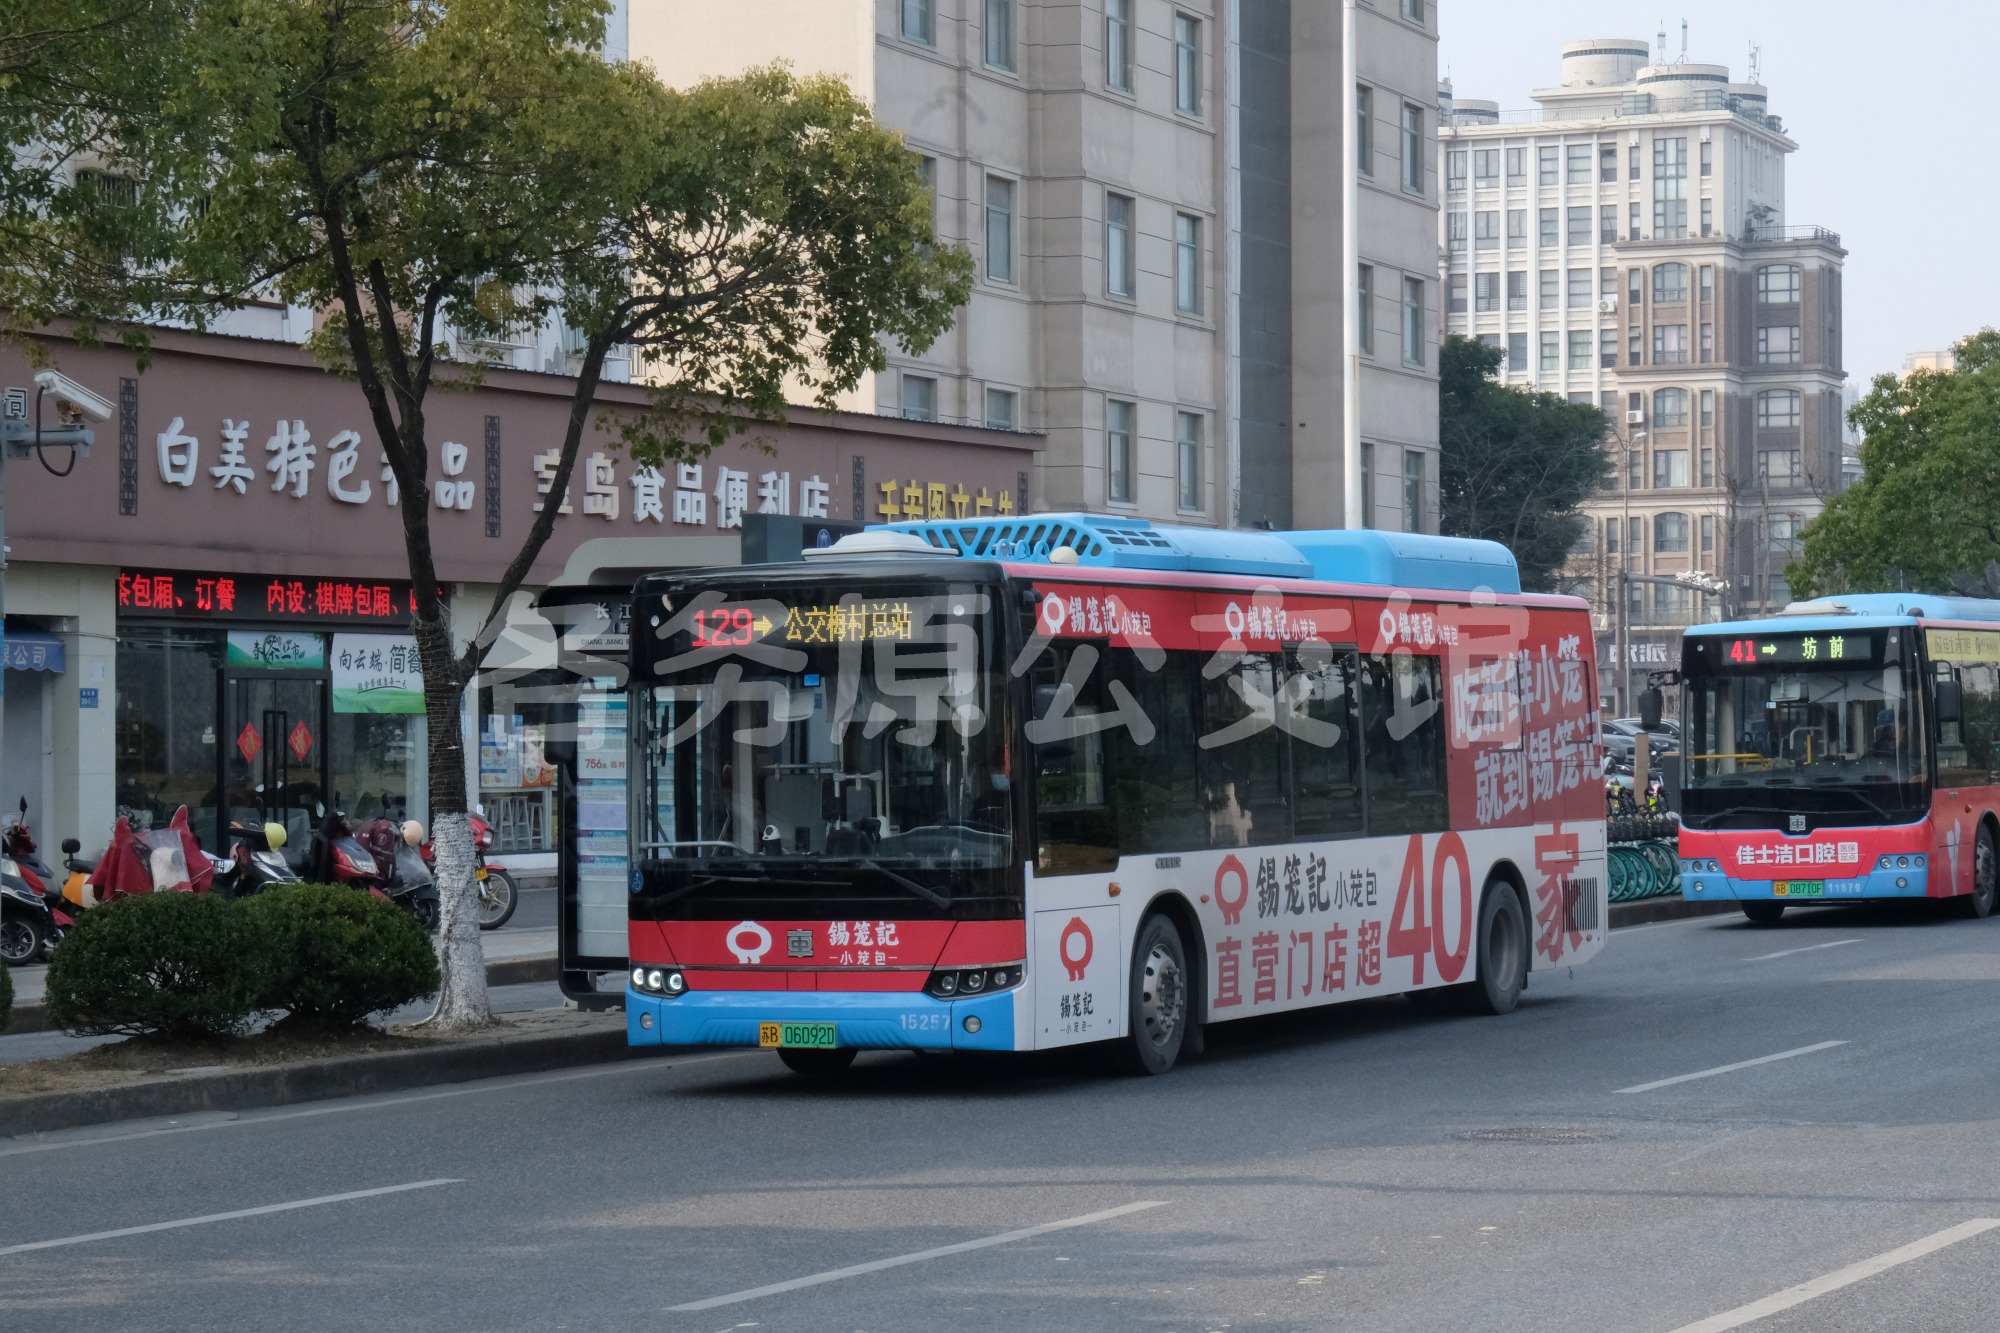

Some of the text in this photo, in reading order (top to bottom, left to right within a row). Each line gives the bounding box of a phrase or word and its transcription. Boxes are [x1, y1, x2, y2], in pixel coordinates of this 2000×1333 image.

[2, 387, 27, 419] 司
[533, 448, 829, 529] 宝岛食品便利店
[267, 579, 442, 617] 内设:棋牌包厢、
[692, 603, 912, 648] 129 公交梅村总站
[1730, 635, 1844, 662] 41 坊前
[1452, 634, 1583, 743] 吃新鲜小笼
[1736, 843, 1836, 865] 佳士洁口腔
[1828, 883, 1860, 893] 11879
[900, 1014, 950, 1030] 15257
